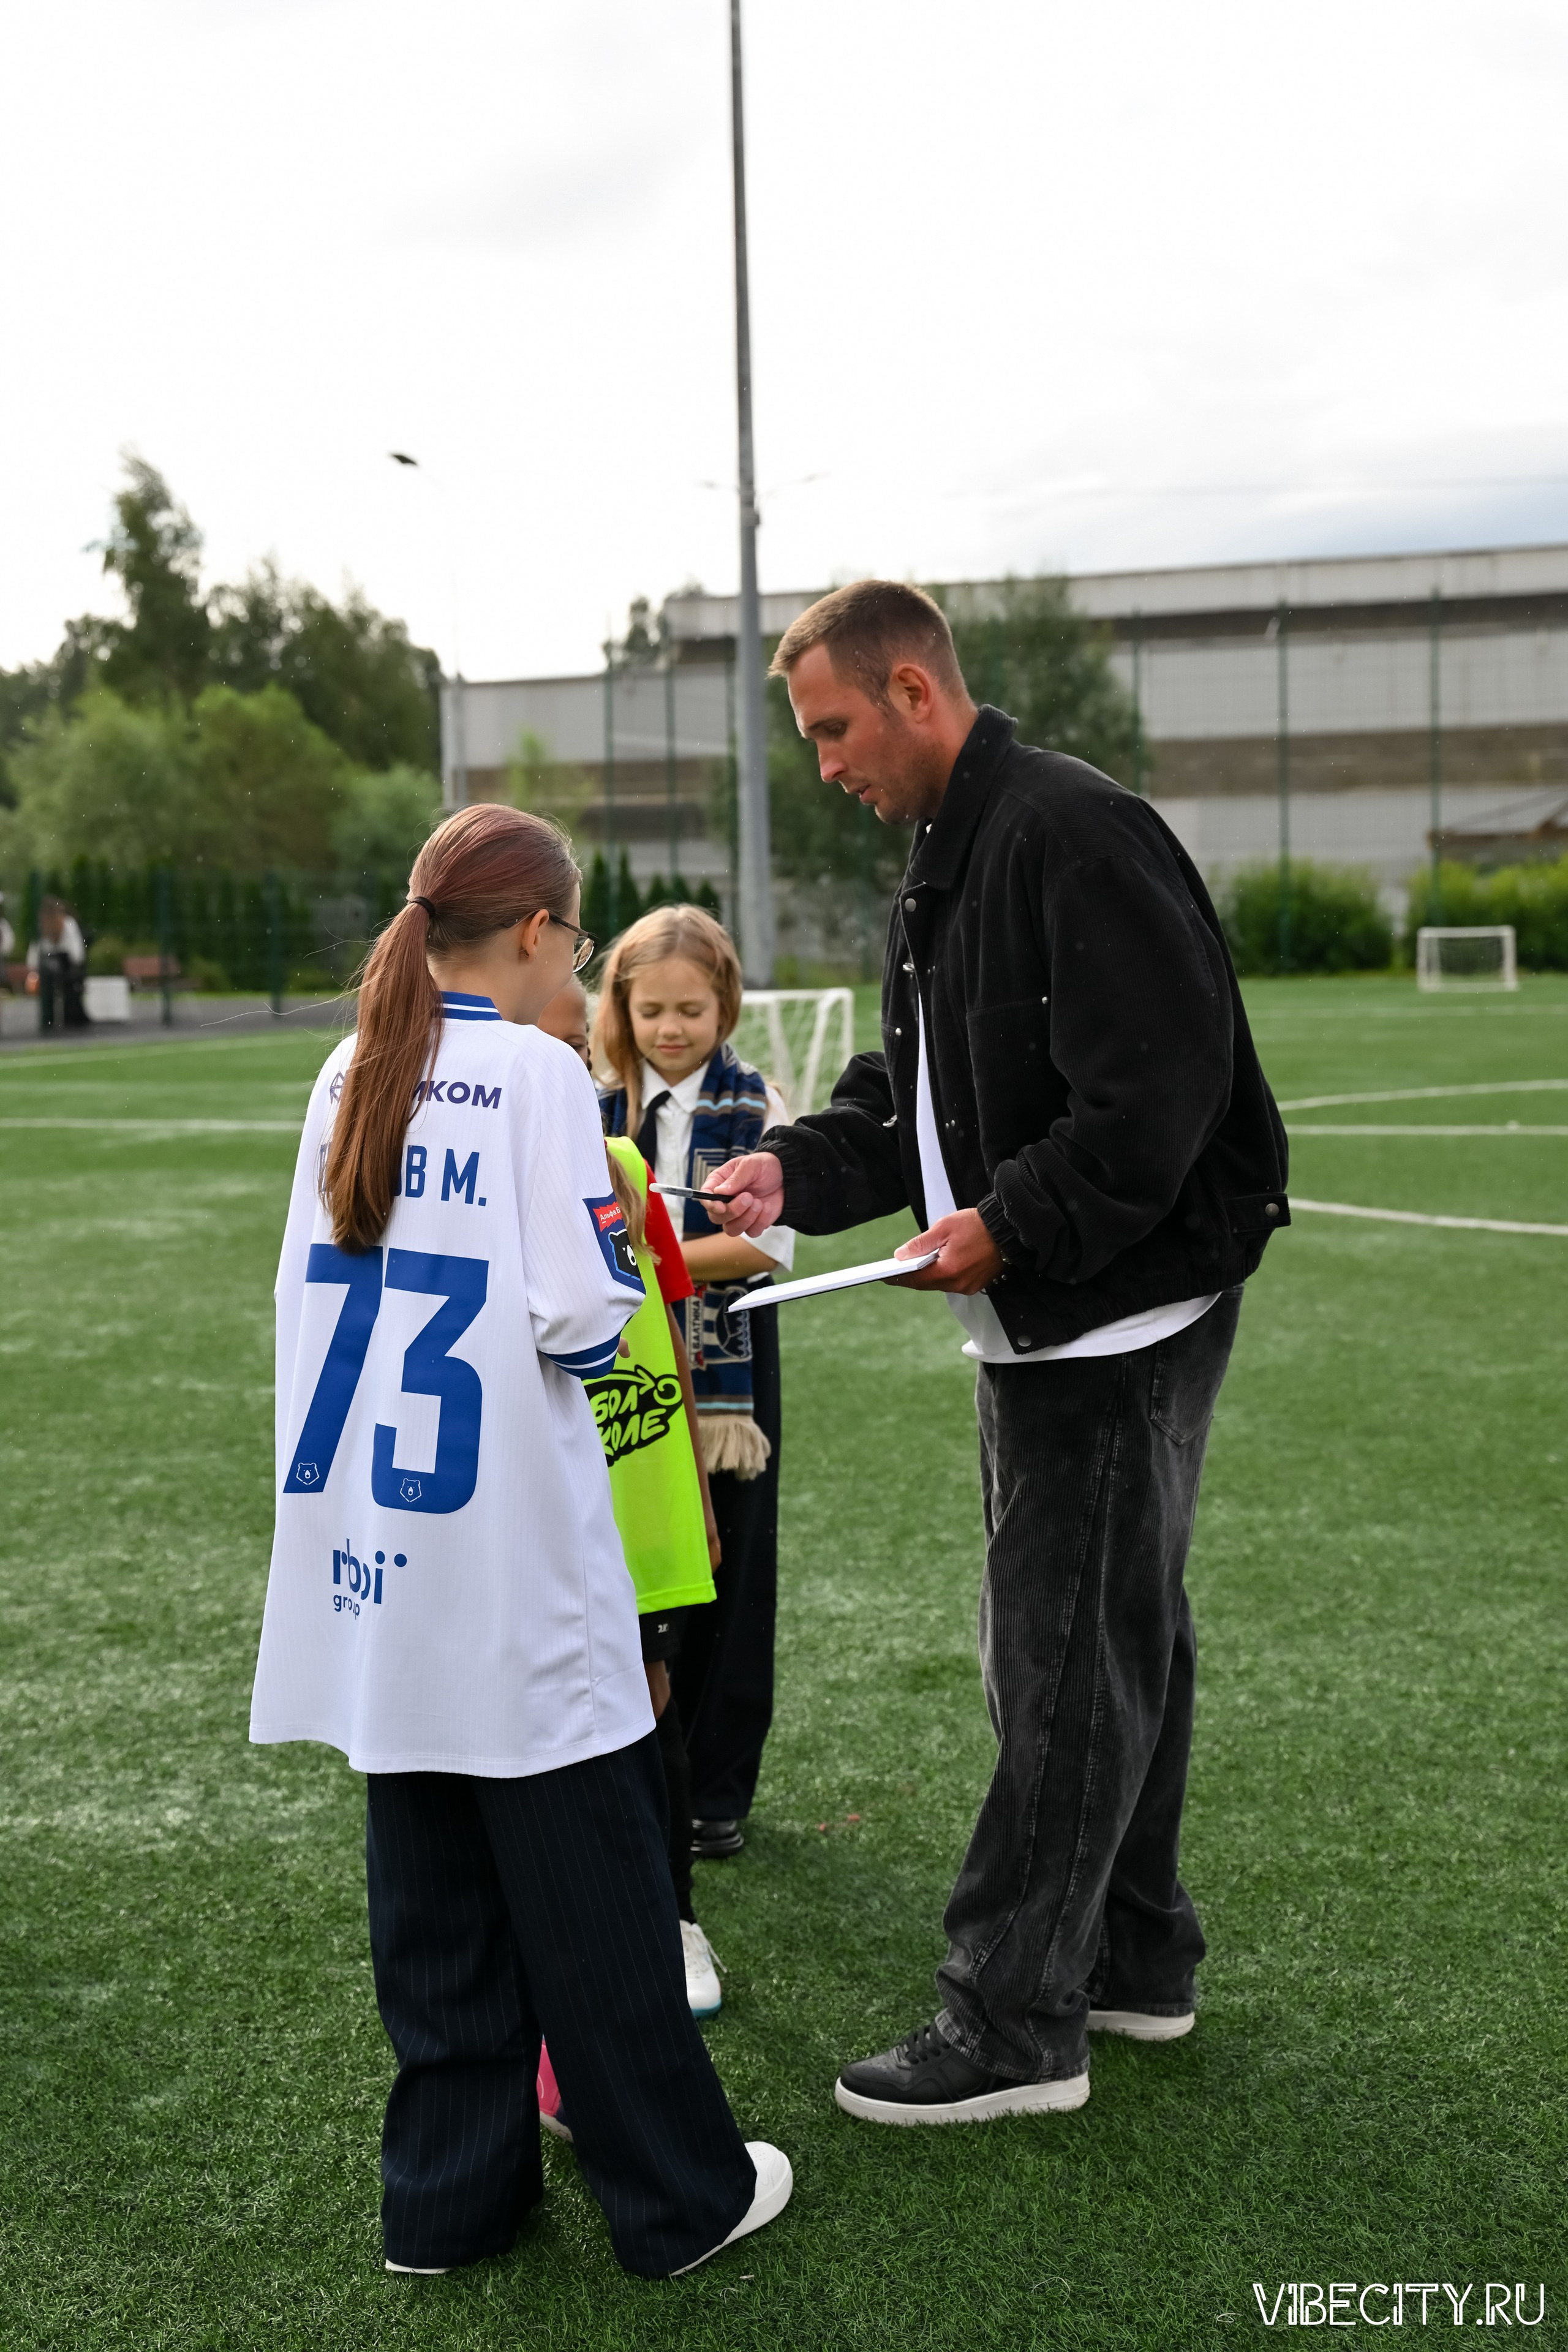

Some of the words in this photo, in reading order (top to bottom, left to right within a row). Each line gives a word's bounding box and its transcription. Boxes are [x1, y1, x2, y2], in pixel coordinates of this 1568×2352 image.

[600, 1210, 617, 1221] Альфа
[282, 1243, 489, 1515] 73
[589, 1384, 638, 1425] БОЛ
[598, 1408, 667, 1457] КОЛЕ
